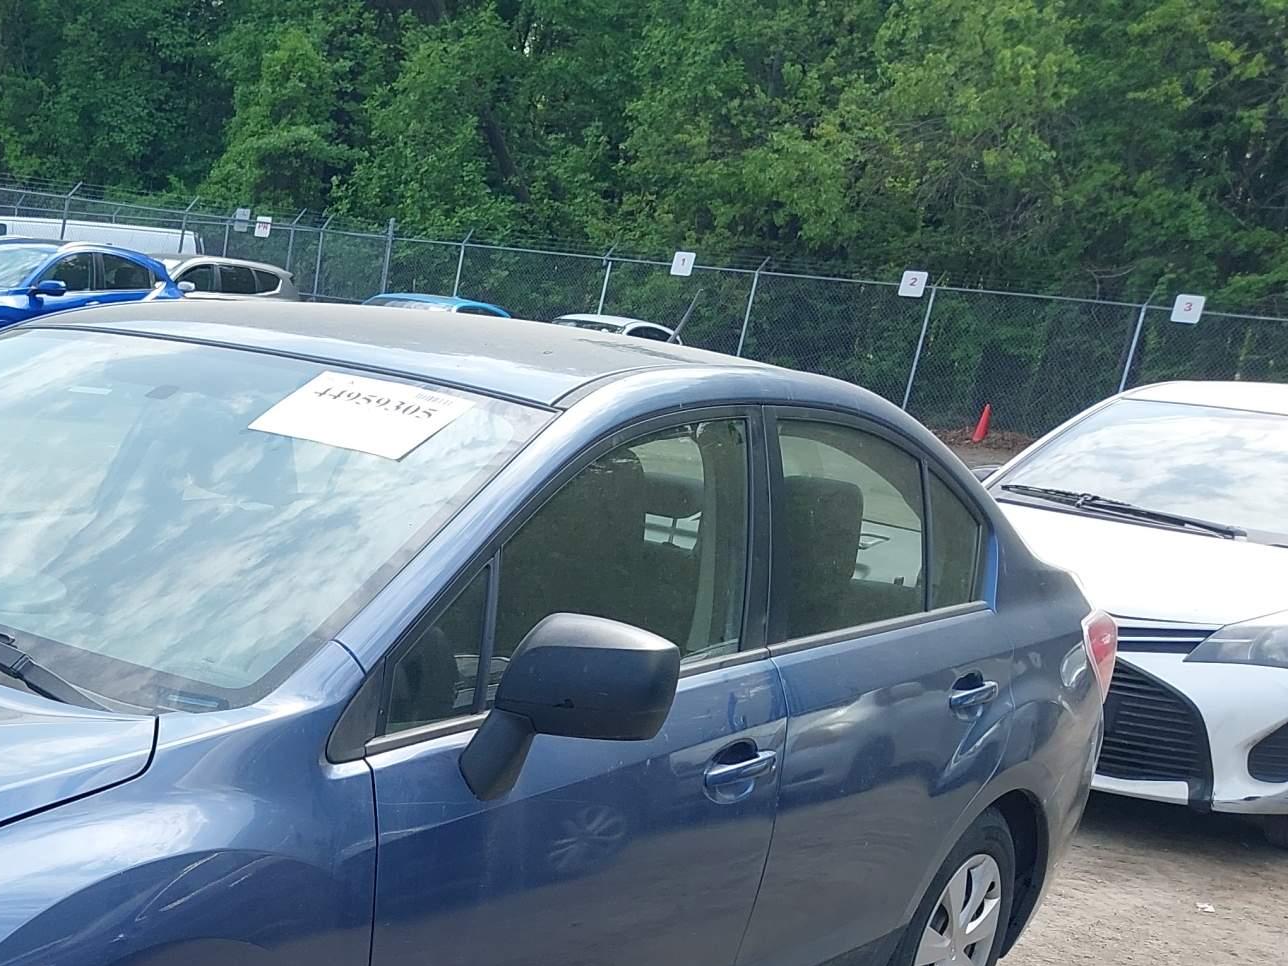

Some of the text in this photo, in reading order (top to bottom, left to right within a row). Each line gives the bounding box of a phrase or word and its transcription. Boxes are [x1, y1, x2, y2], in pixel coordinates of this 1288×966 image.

[909, 277, 918, 287] 2
[1183, 302, 1193, 312] 3
[313, 386, 438, 419] 44959305
